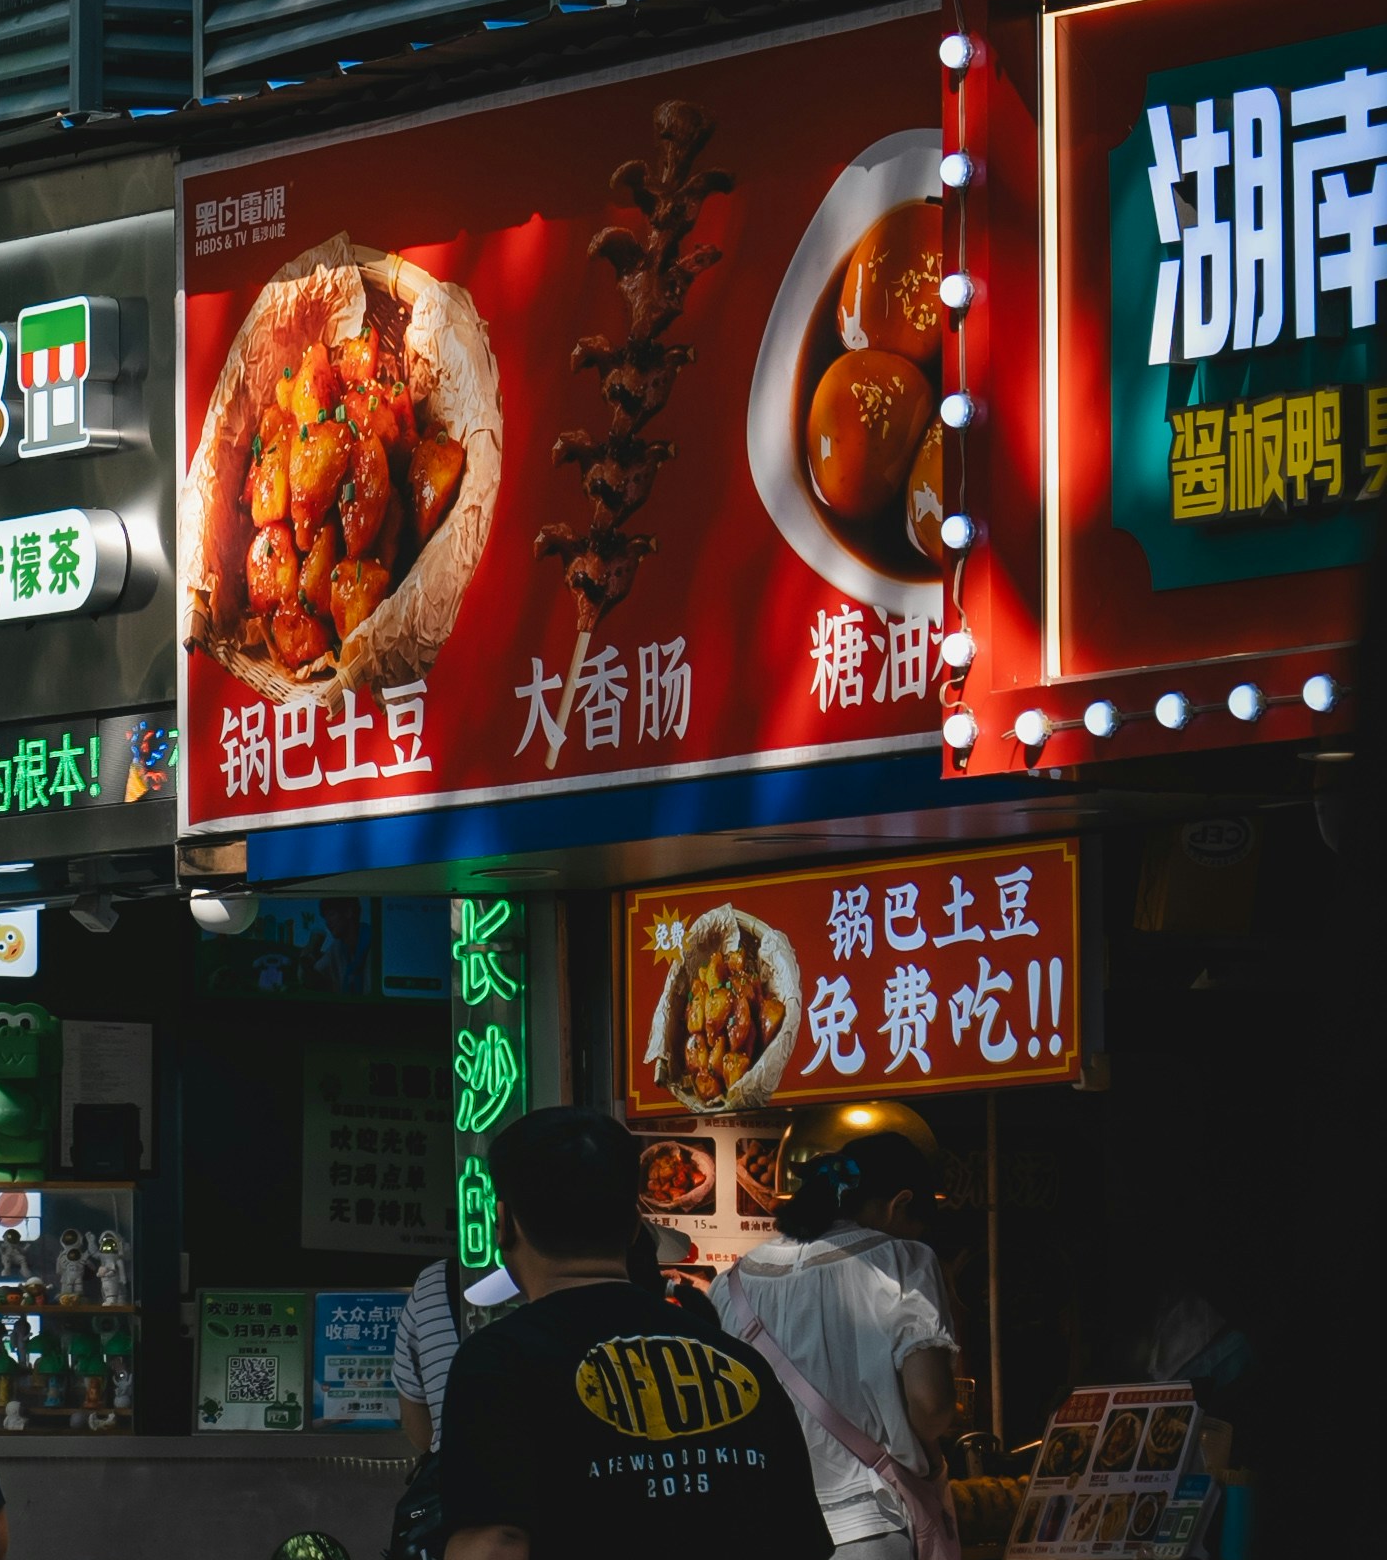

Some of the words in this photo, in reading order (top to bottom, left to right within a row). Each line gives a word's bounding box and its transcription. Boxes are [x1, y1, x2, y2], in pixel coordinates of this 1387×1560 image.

[1148, 68, 1387, 365] 湖南
[195, 236, 223, 257] HBDS
[224, 234, 233, 249] &
[235, 230, 248, 248] TV
[1171, 390, 1342, 520] 酱板鸭
[515, 635, 693, 760] 大香肠
[219, 678, 433, 800] 锅巴土豆
[825, 865, 1041, 963] 锅巴土豆
[654, 920, 687, 952] 免费
[799, 956, 1065, 1076] 免费吃!!
[207, 1301, 273, 1317] 欢迎光临
[330, 1305, 402, 1323] 大众点评
[234, 1323, 300, 1339] 扫码点单
[588, 1461, 600, 1478] A
[647, 1473, 710, 1498] 2025
